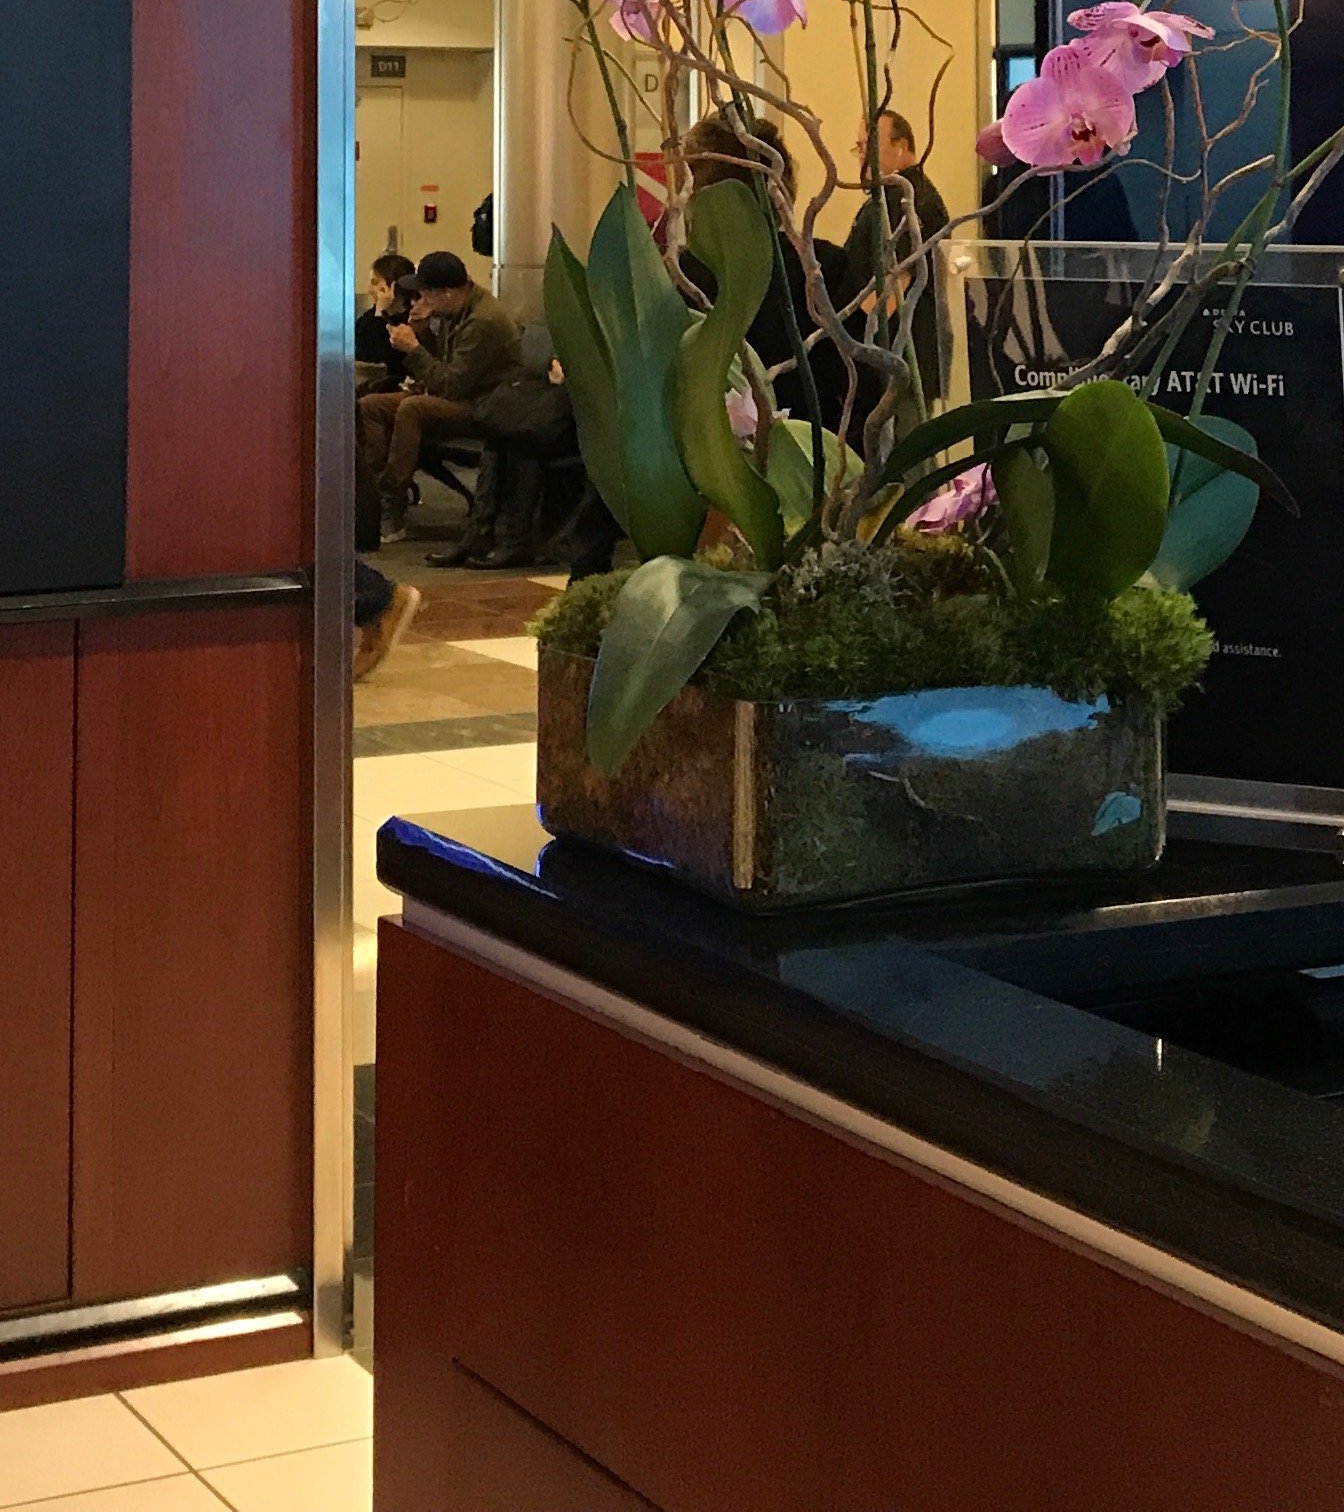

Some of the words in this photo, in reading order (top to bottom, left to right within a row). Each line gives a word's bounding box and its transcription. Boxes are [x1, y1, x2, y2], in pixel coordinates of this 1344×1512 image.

[1250, 320, 1294, 336] CLUB
[1231, 372, 1285, 397] Wi-Fi
[1222, 643, 1283, 658] assistance.
